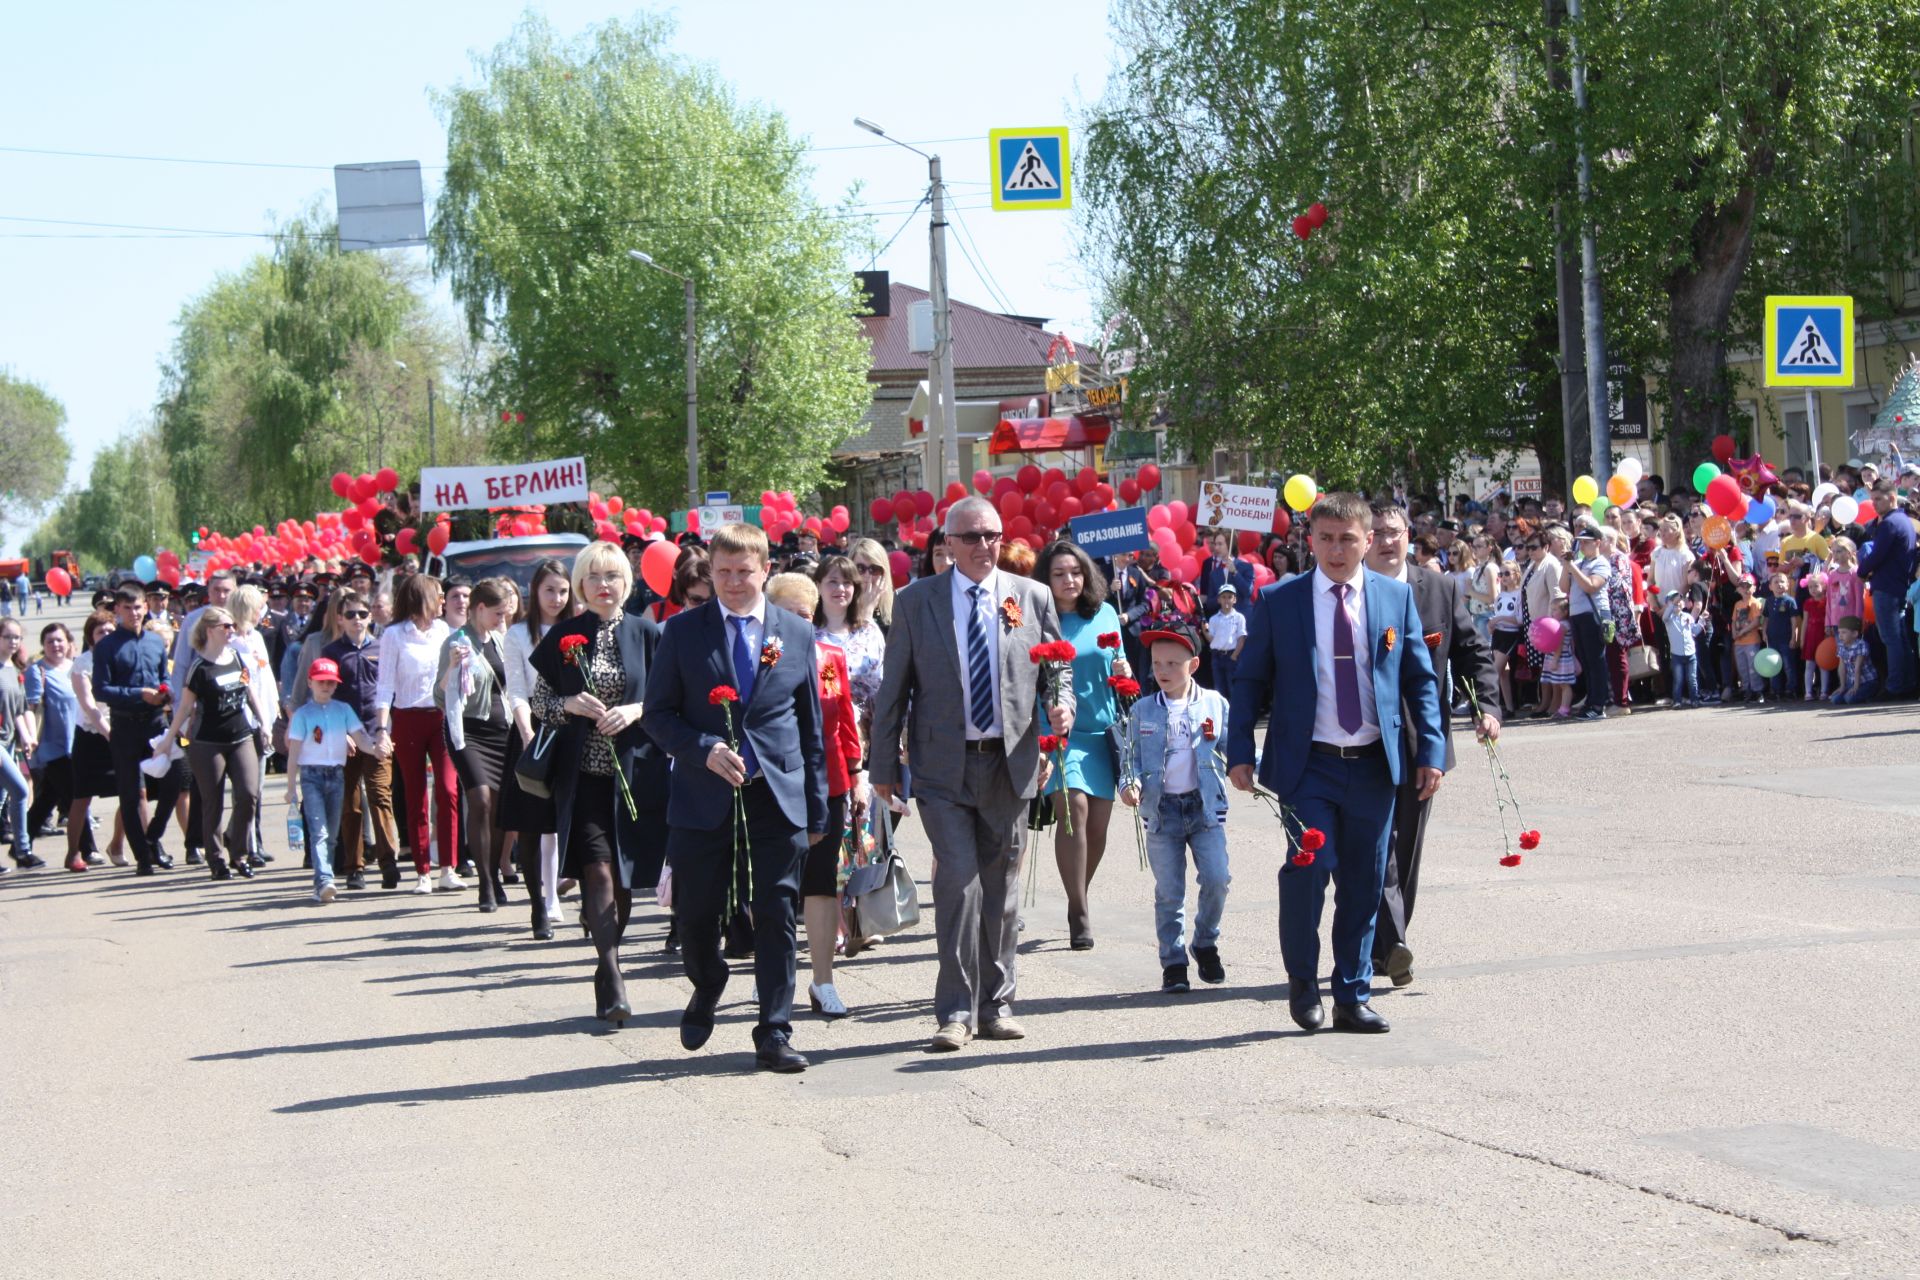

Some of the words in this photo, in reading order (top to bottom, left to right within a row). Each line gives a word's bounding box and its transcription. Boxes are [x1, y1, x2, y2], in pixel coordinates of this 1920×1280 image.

[435, 481, 468, 507] НА
[484, 462, 584, 501] БЕРЛИН!
[1231, 495, 1238, 504] С
[1239, 496, 1270, 507] ДНЕМ
[1226, 508, 1272, 521] ПОБЕДЫ!
[1077, 522, 1143, 545] ОБРАЗОВАНИЕ
